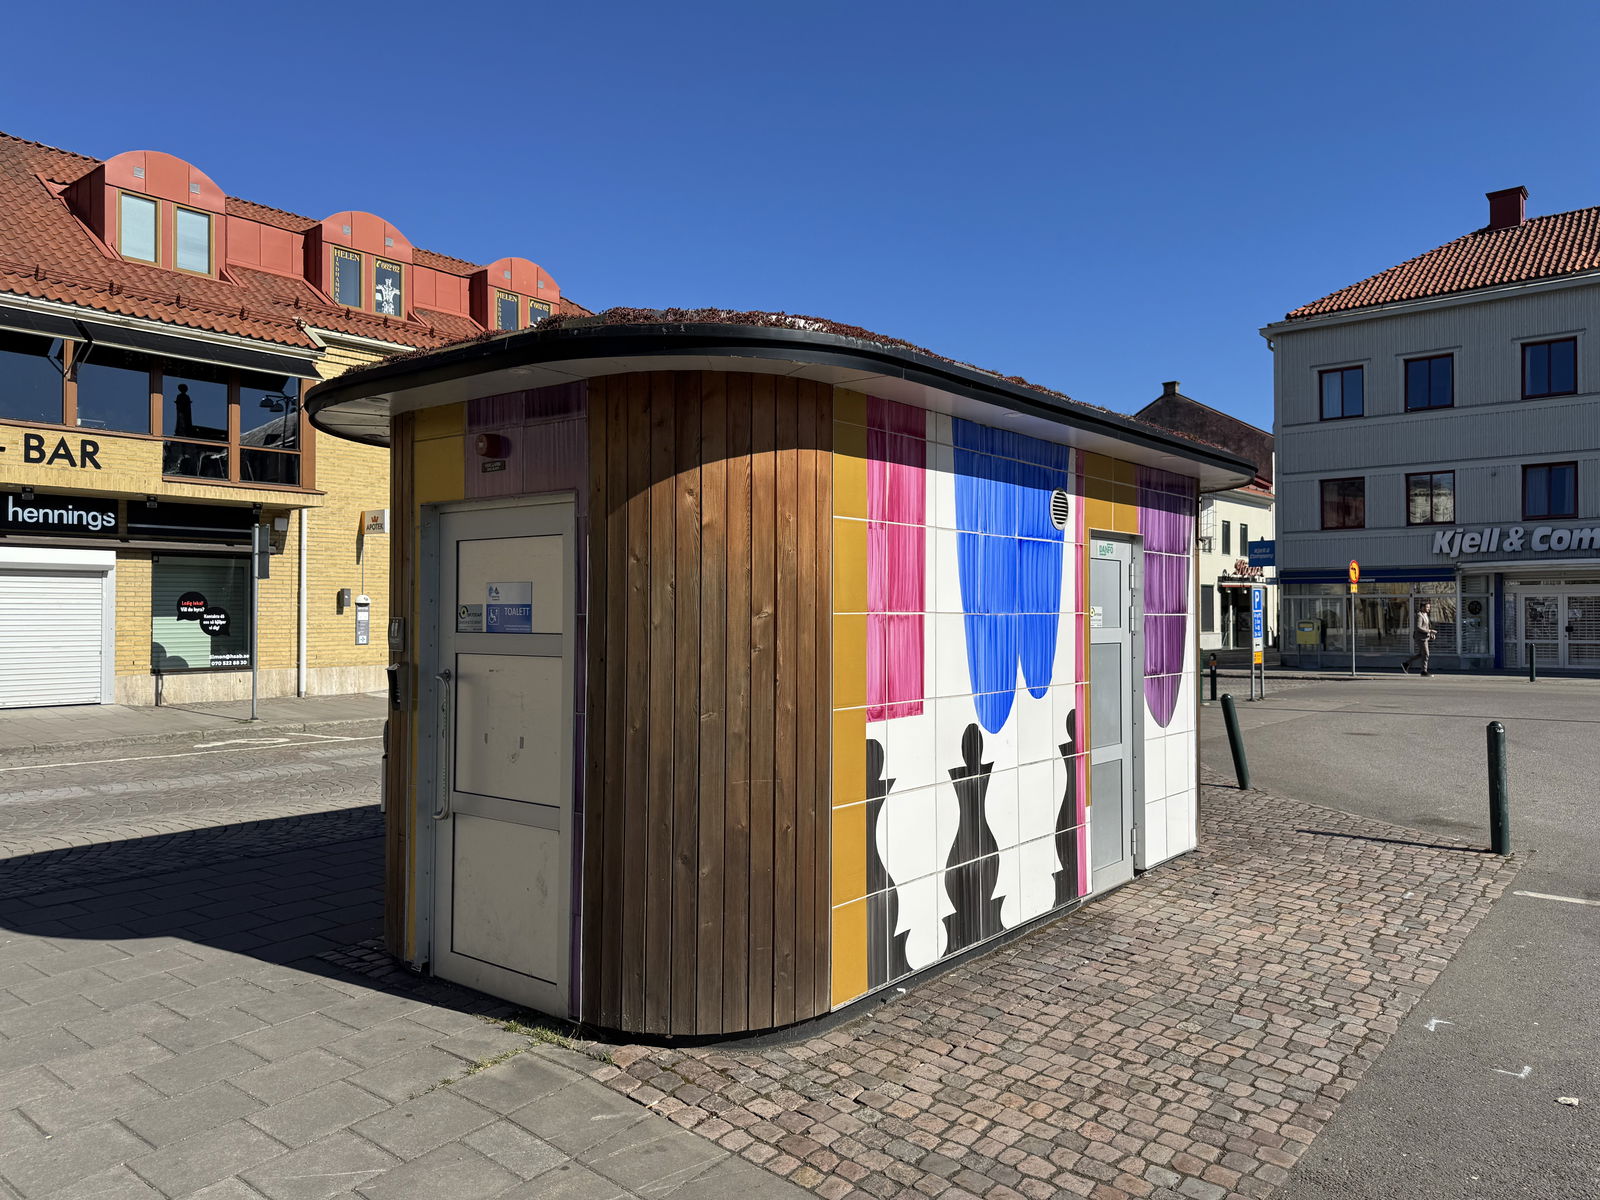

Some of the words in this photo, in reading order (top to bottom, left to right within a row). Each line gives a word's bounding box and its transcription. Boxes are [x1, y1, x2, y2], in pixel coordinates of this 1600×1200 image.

[334, 249, 360, 262] HELEN
[496, 291, 518, 302] HELEN
[23, 433, 103, 470] BAR
[8, 495, 116, 531] hennings
[366, 523, 384, 531] APOTEK
[1432, 527, 1501, 558] Kjell
[1502, 526, 1526, 552] &
[1530, 526, 1600, 551] Com
[1254, 591, 1260, 609] P
[504, 607, 530, 616] TOALETT
